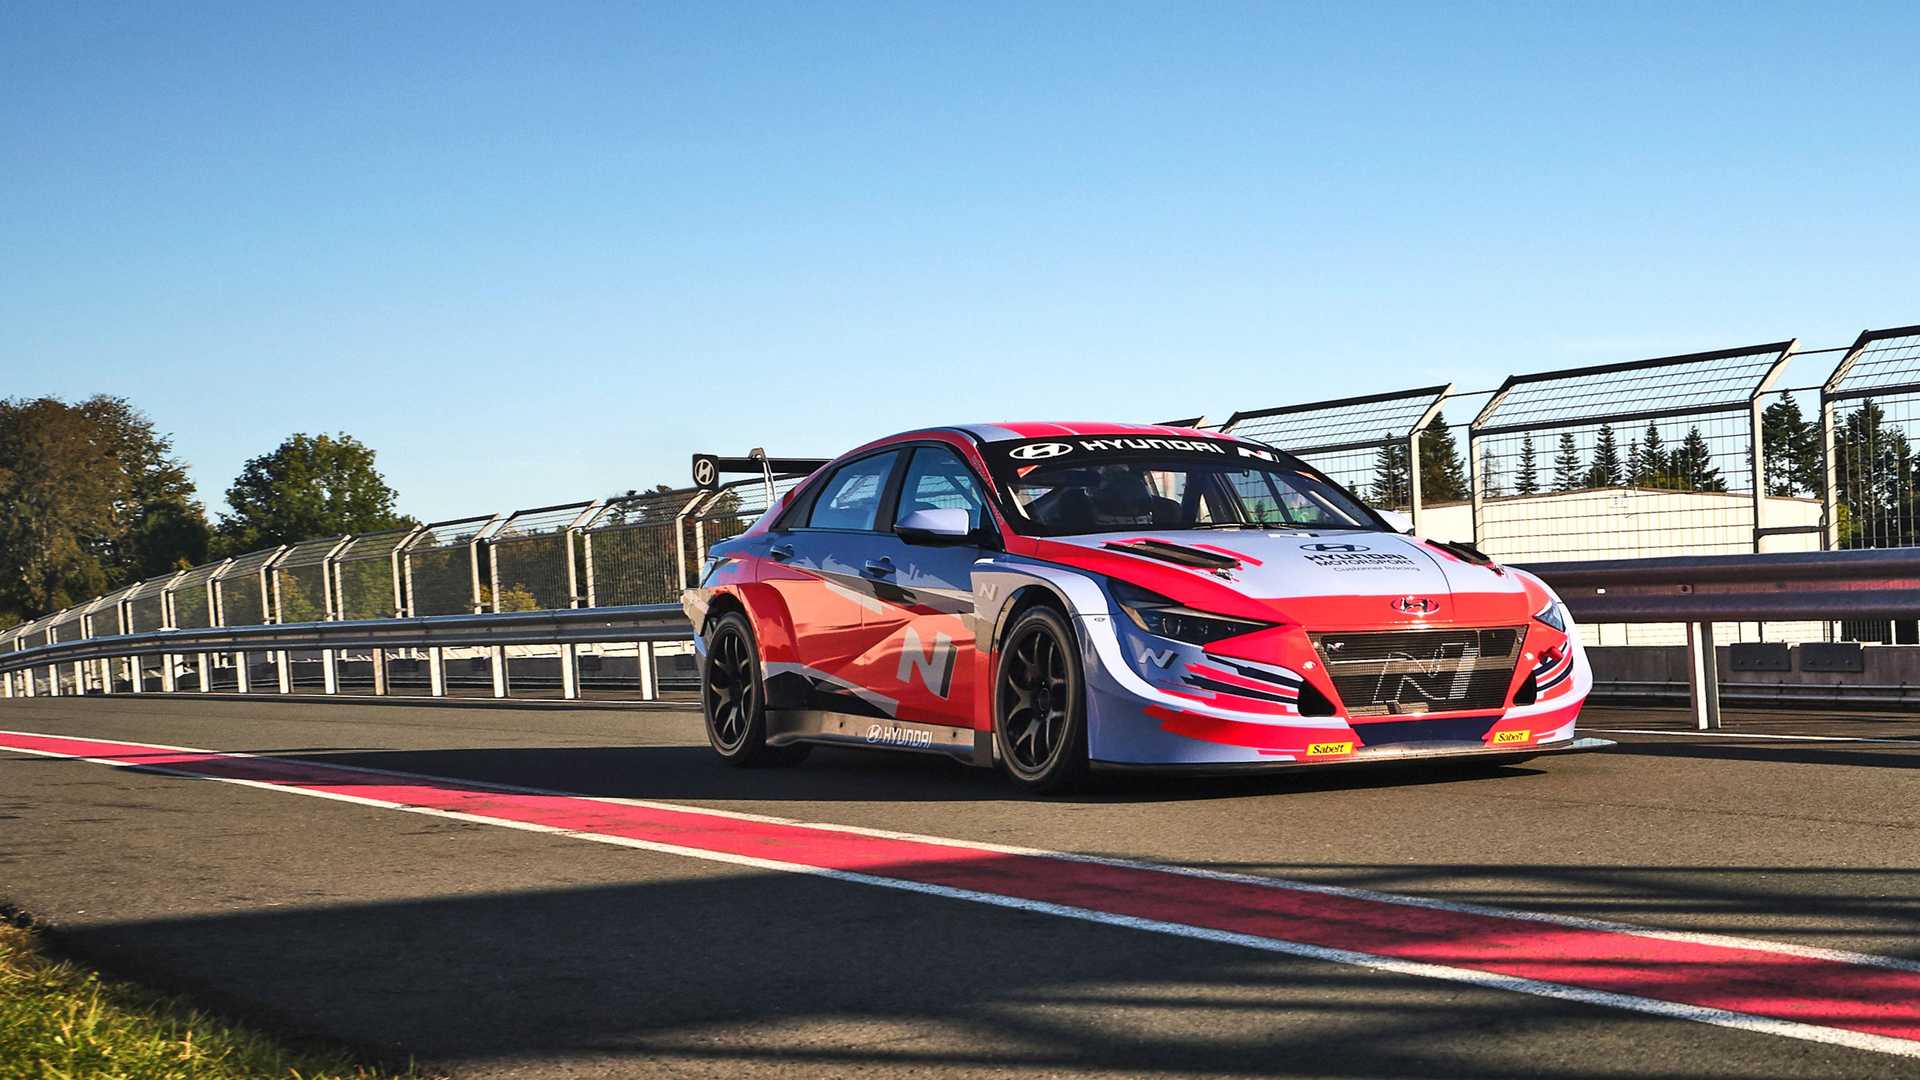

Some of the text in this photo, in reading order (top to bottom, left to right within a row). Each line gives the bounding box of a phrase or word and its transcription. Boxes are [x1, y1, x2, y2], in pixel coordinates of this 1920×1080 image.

[1079, 438, 1225, 454] HYUNDAI
[1303, 553, 1408, 561] HYUNDAI
[896, 626, 958, 700] N
[1138, 647, 1179, 669] N
[1371, 642, 1481, 704] N
[883, 726, 933, 749] HYUNDAI
